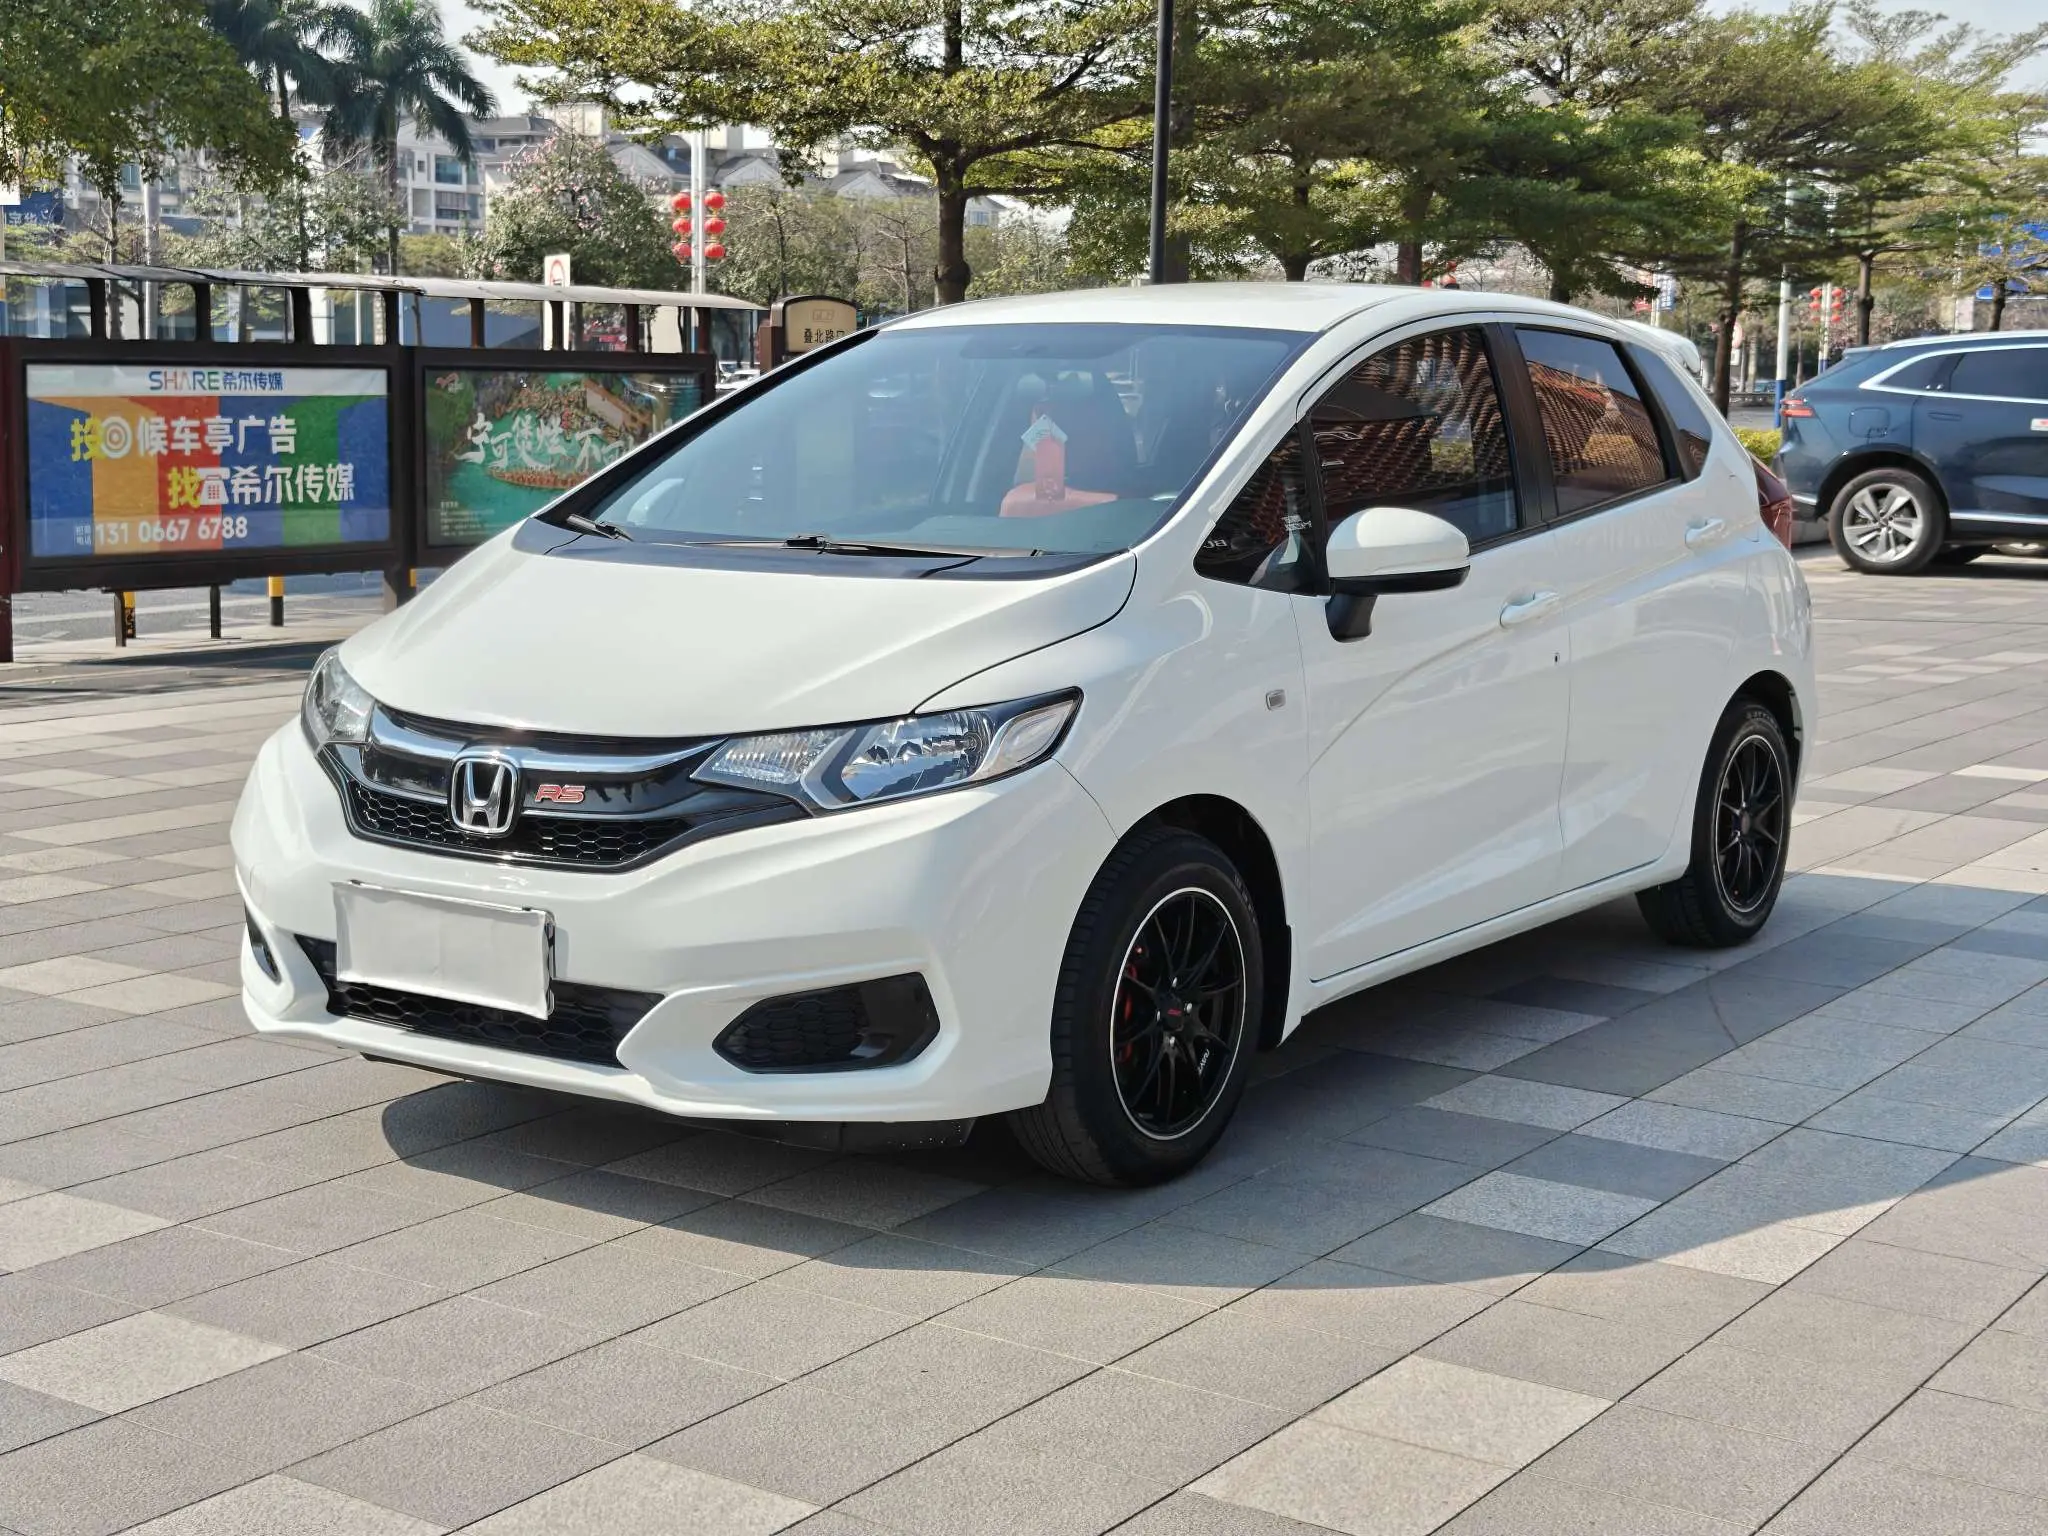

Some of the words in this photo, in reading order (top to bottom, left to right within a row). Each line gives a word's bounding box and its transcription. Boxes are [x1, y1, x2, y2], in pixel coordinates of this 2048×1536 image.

[149, 371, 220, 391] SHARE
[222, 371, 284, 391] 希尔传媒
[137, 414, 297, 456] 候车亭广告
[230, 463, 354, 505] 希尔传媒
[95, 522, 129, 545] 131
[138, 521, 189, 542] 0667
[198, 516, 248, 540] 6788
[535, 784, 586, 803] RS
